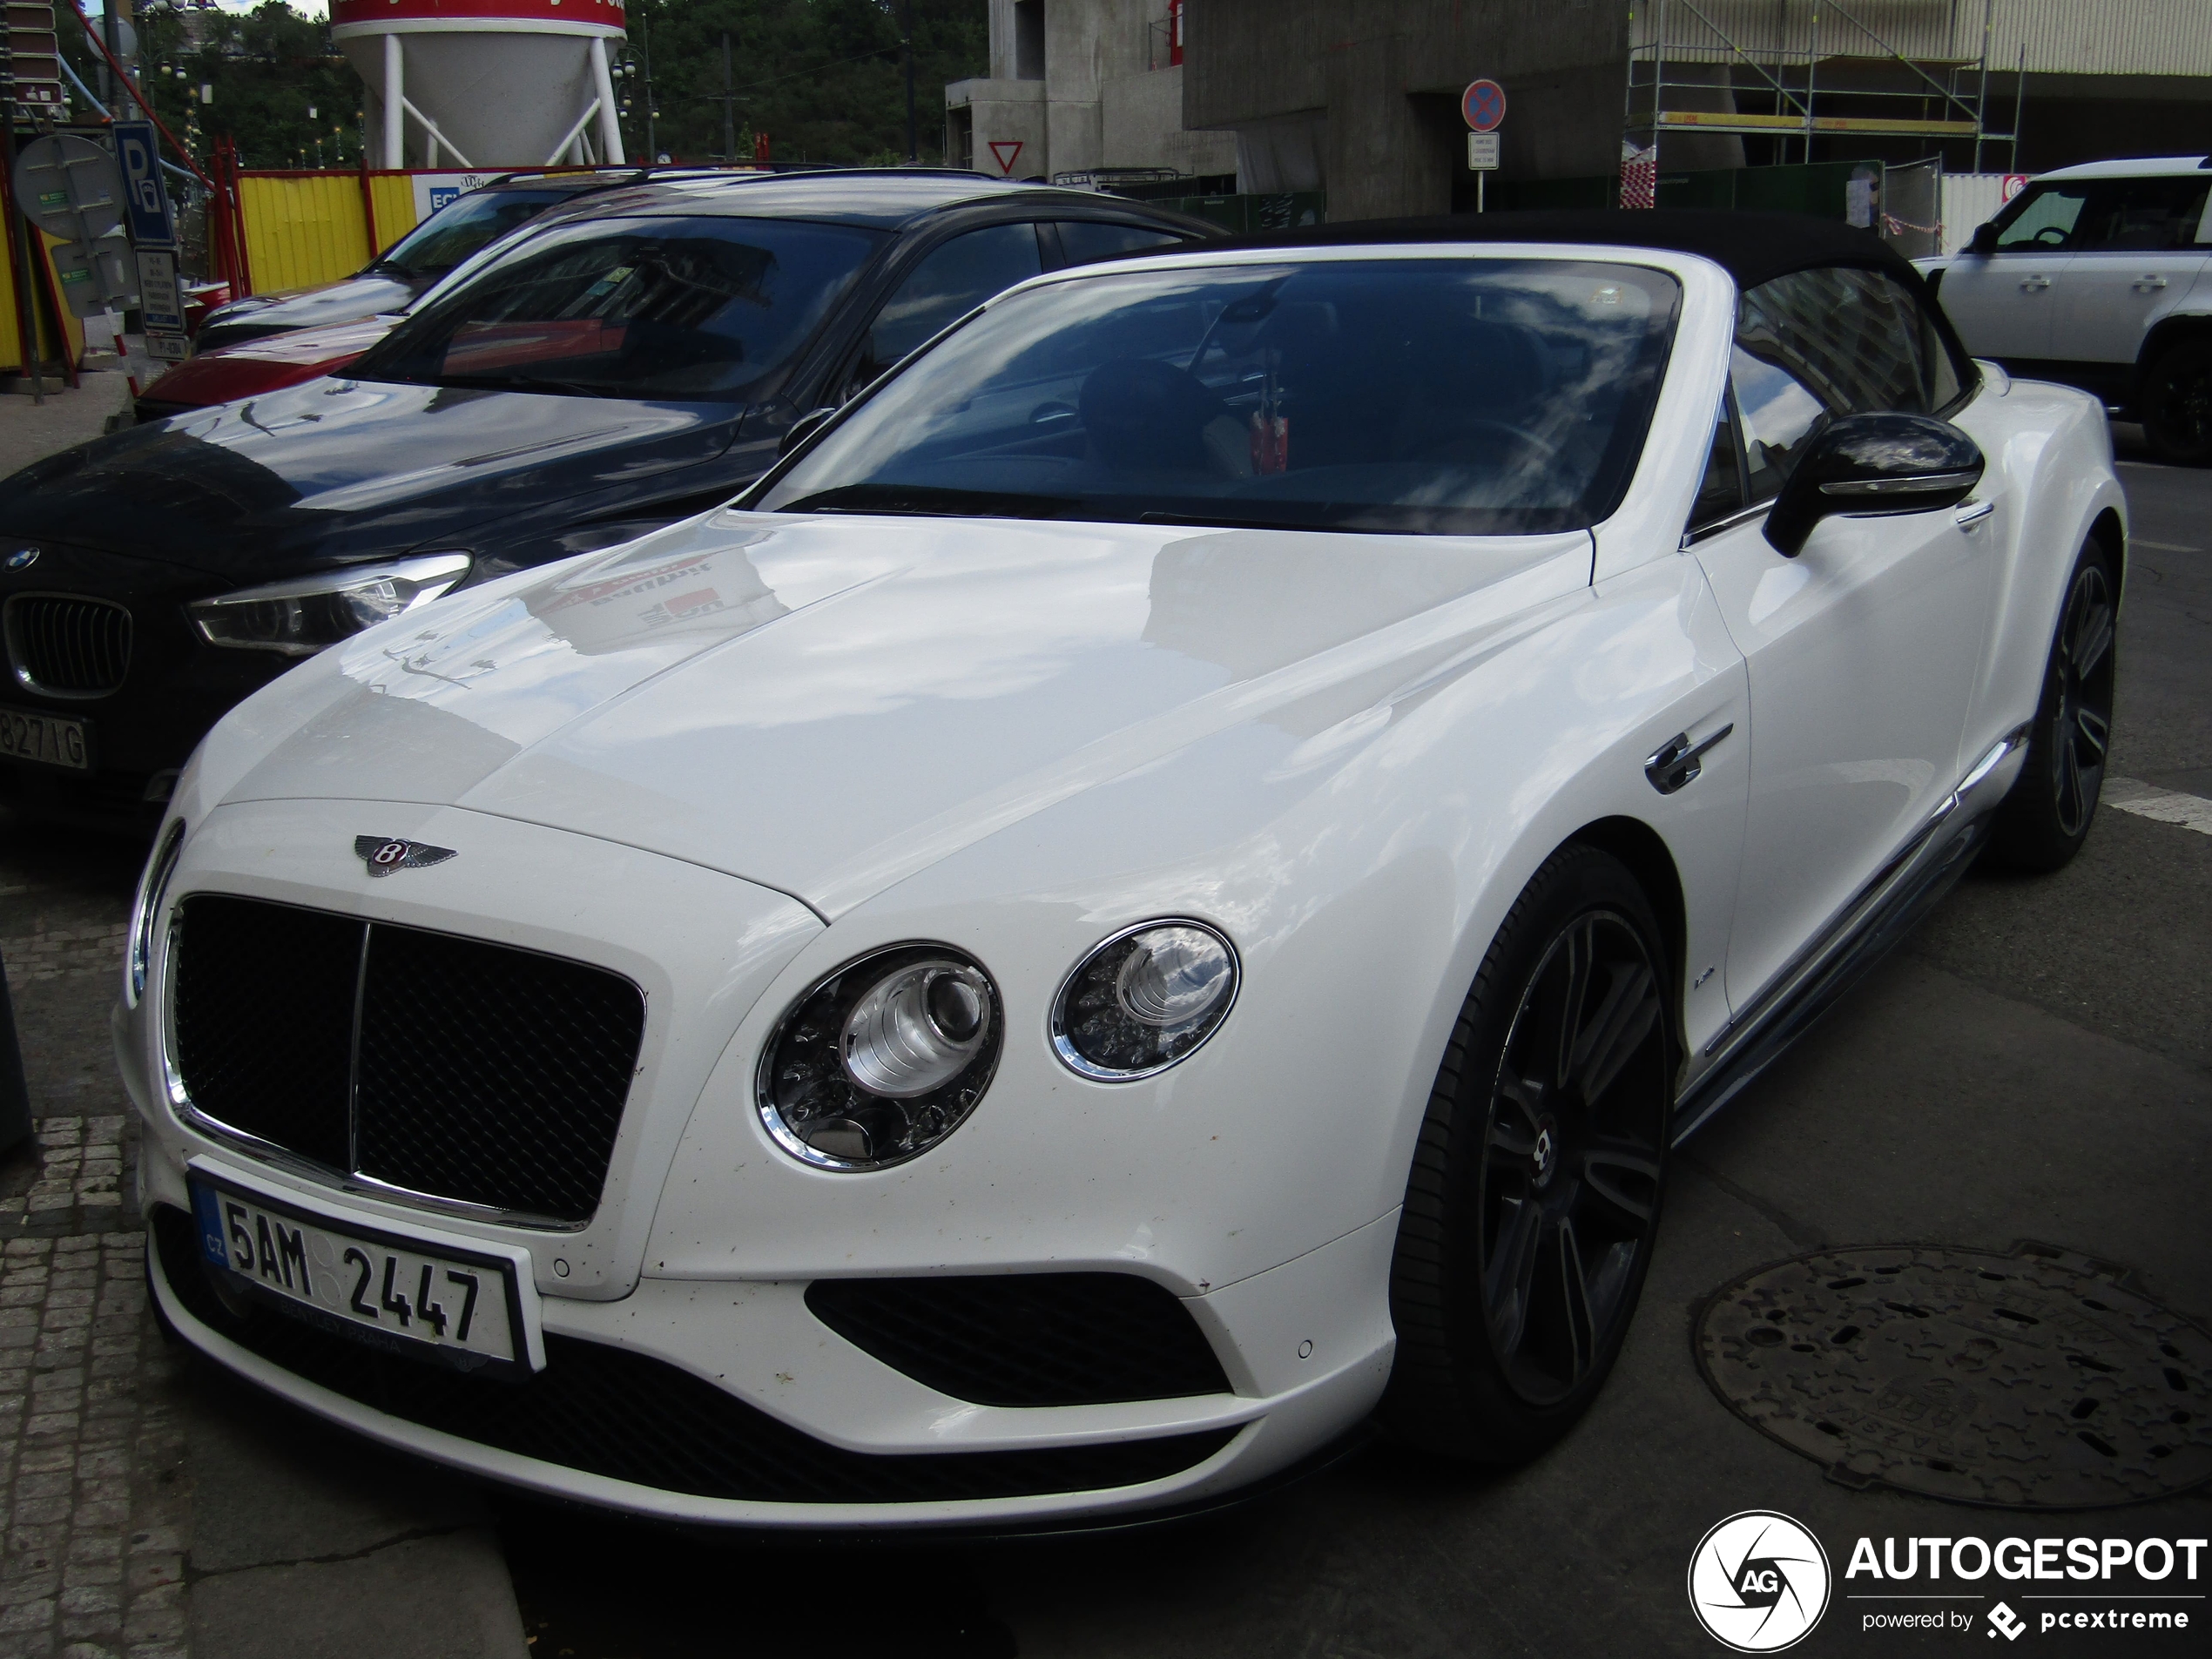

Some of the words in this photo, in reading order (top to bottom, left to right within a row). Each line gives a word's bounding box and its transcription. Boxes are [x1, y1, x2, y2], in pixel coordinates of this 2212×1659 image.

[123, 138, 148, 205] P
[374, 844, 402, 863] B
[206, 1233, 226, 1258] CZ
[226, 1202, 313, 1296] 5AM
[344, 1247, 479, 1341] 2447
[280, 1300, 341, 1333] BENTLEY
[347, 1326, 401, 1352] PRAHA
